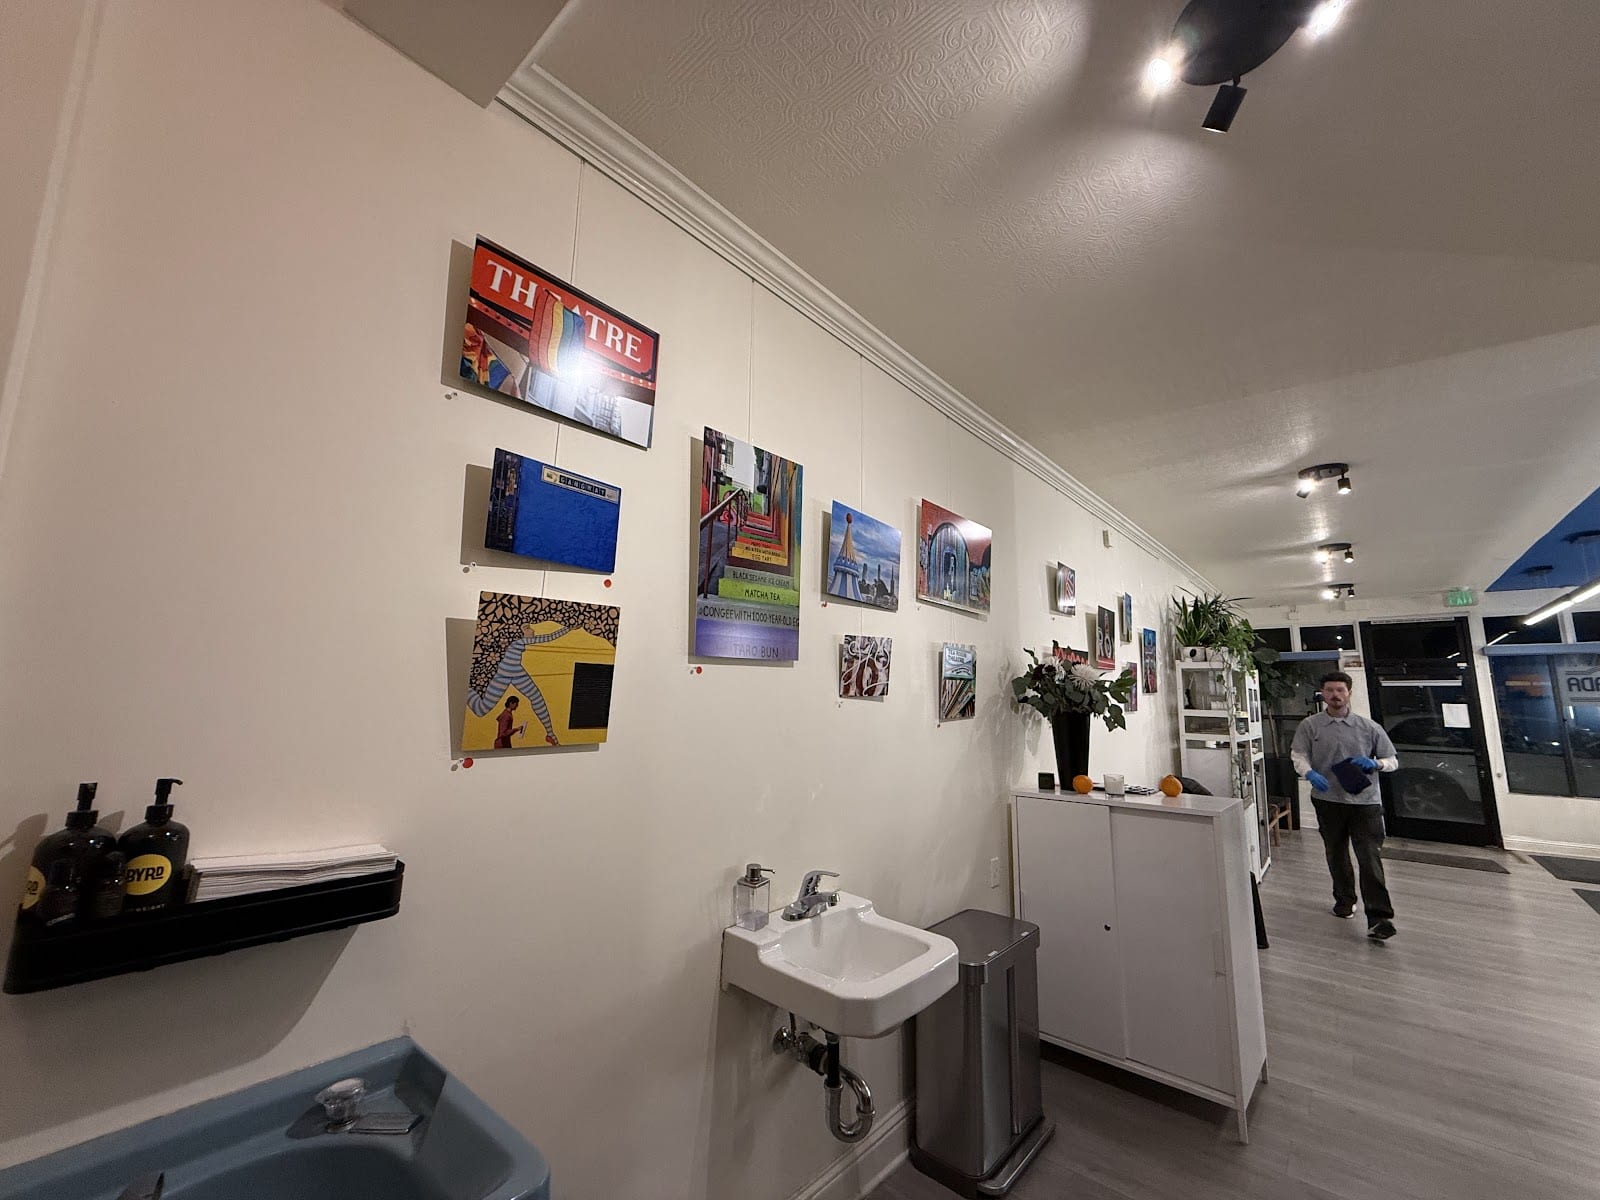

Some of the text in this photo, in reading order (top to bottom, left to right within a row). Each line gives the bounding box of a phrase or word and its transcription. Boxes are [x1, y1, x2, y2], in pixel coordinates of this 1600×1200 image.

[487, 259, 642, 363] THTRE
[744, 589, 781, 601] MATCHA TEA
[734, 609, 751, 620] WITH
[733, 643, 779, 658] TARO BUN
[125, 866, 164, 883] BYRD
